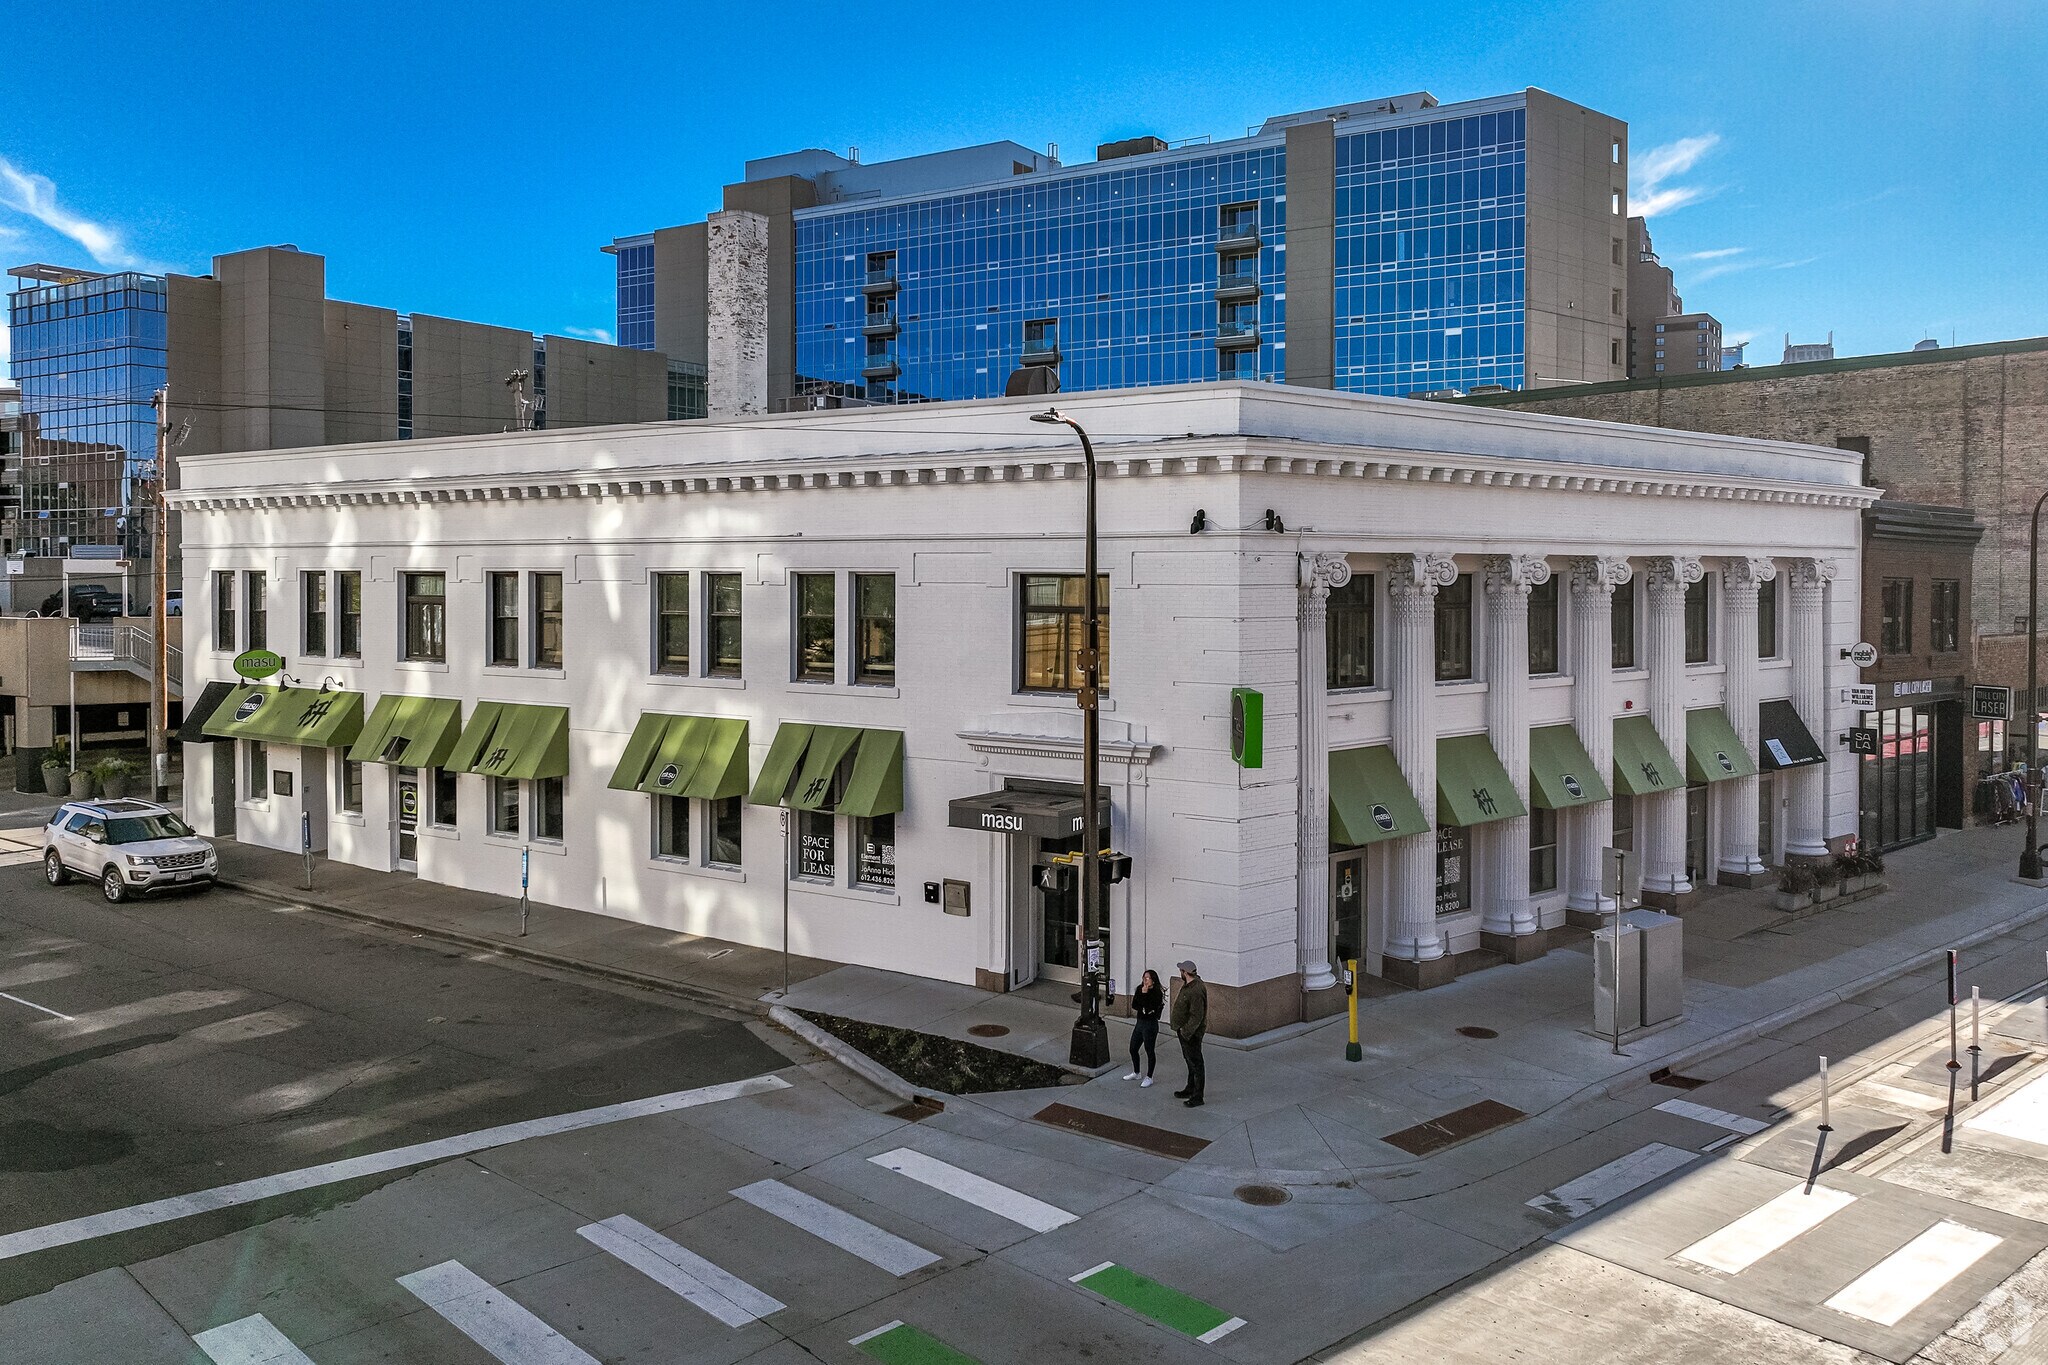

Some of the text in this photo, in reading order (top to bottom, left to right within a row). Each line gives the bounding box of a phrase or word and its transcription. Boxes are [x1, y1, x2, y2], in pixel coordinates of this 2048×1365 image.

[241, 657, 276, 668] masu
[1976, 690, 2005, 701] MILL CITY
[240, 702, 260, 710] masu
[1975, 700, 2006, 714] LASER
[1855, 732, 1871, 741] SA
[1855, 741, 1871, 749] LA
[981, 812, 1023, 831] masu
[1375, 813, 1391, 821] masu
[802, 835, 829, 849] SPACE
[1437, 838, 1464, 853] LEASE
[803, 848, 825, 861] FOR
[1436, 900, 1460, 914] 36.8200
